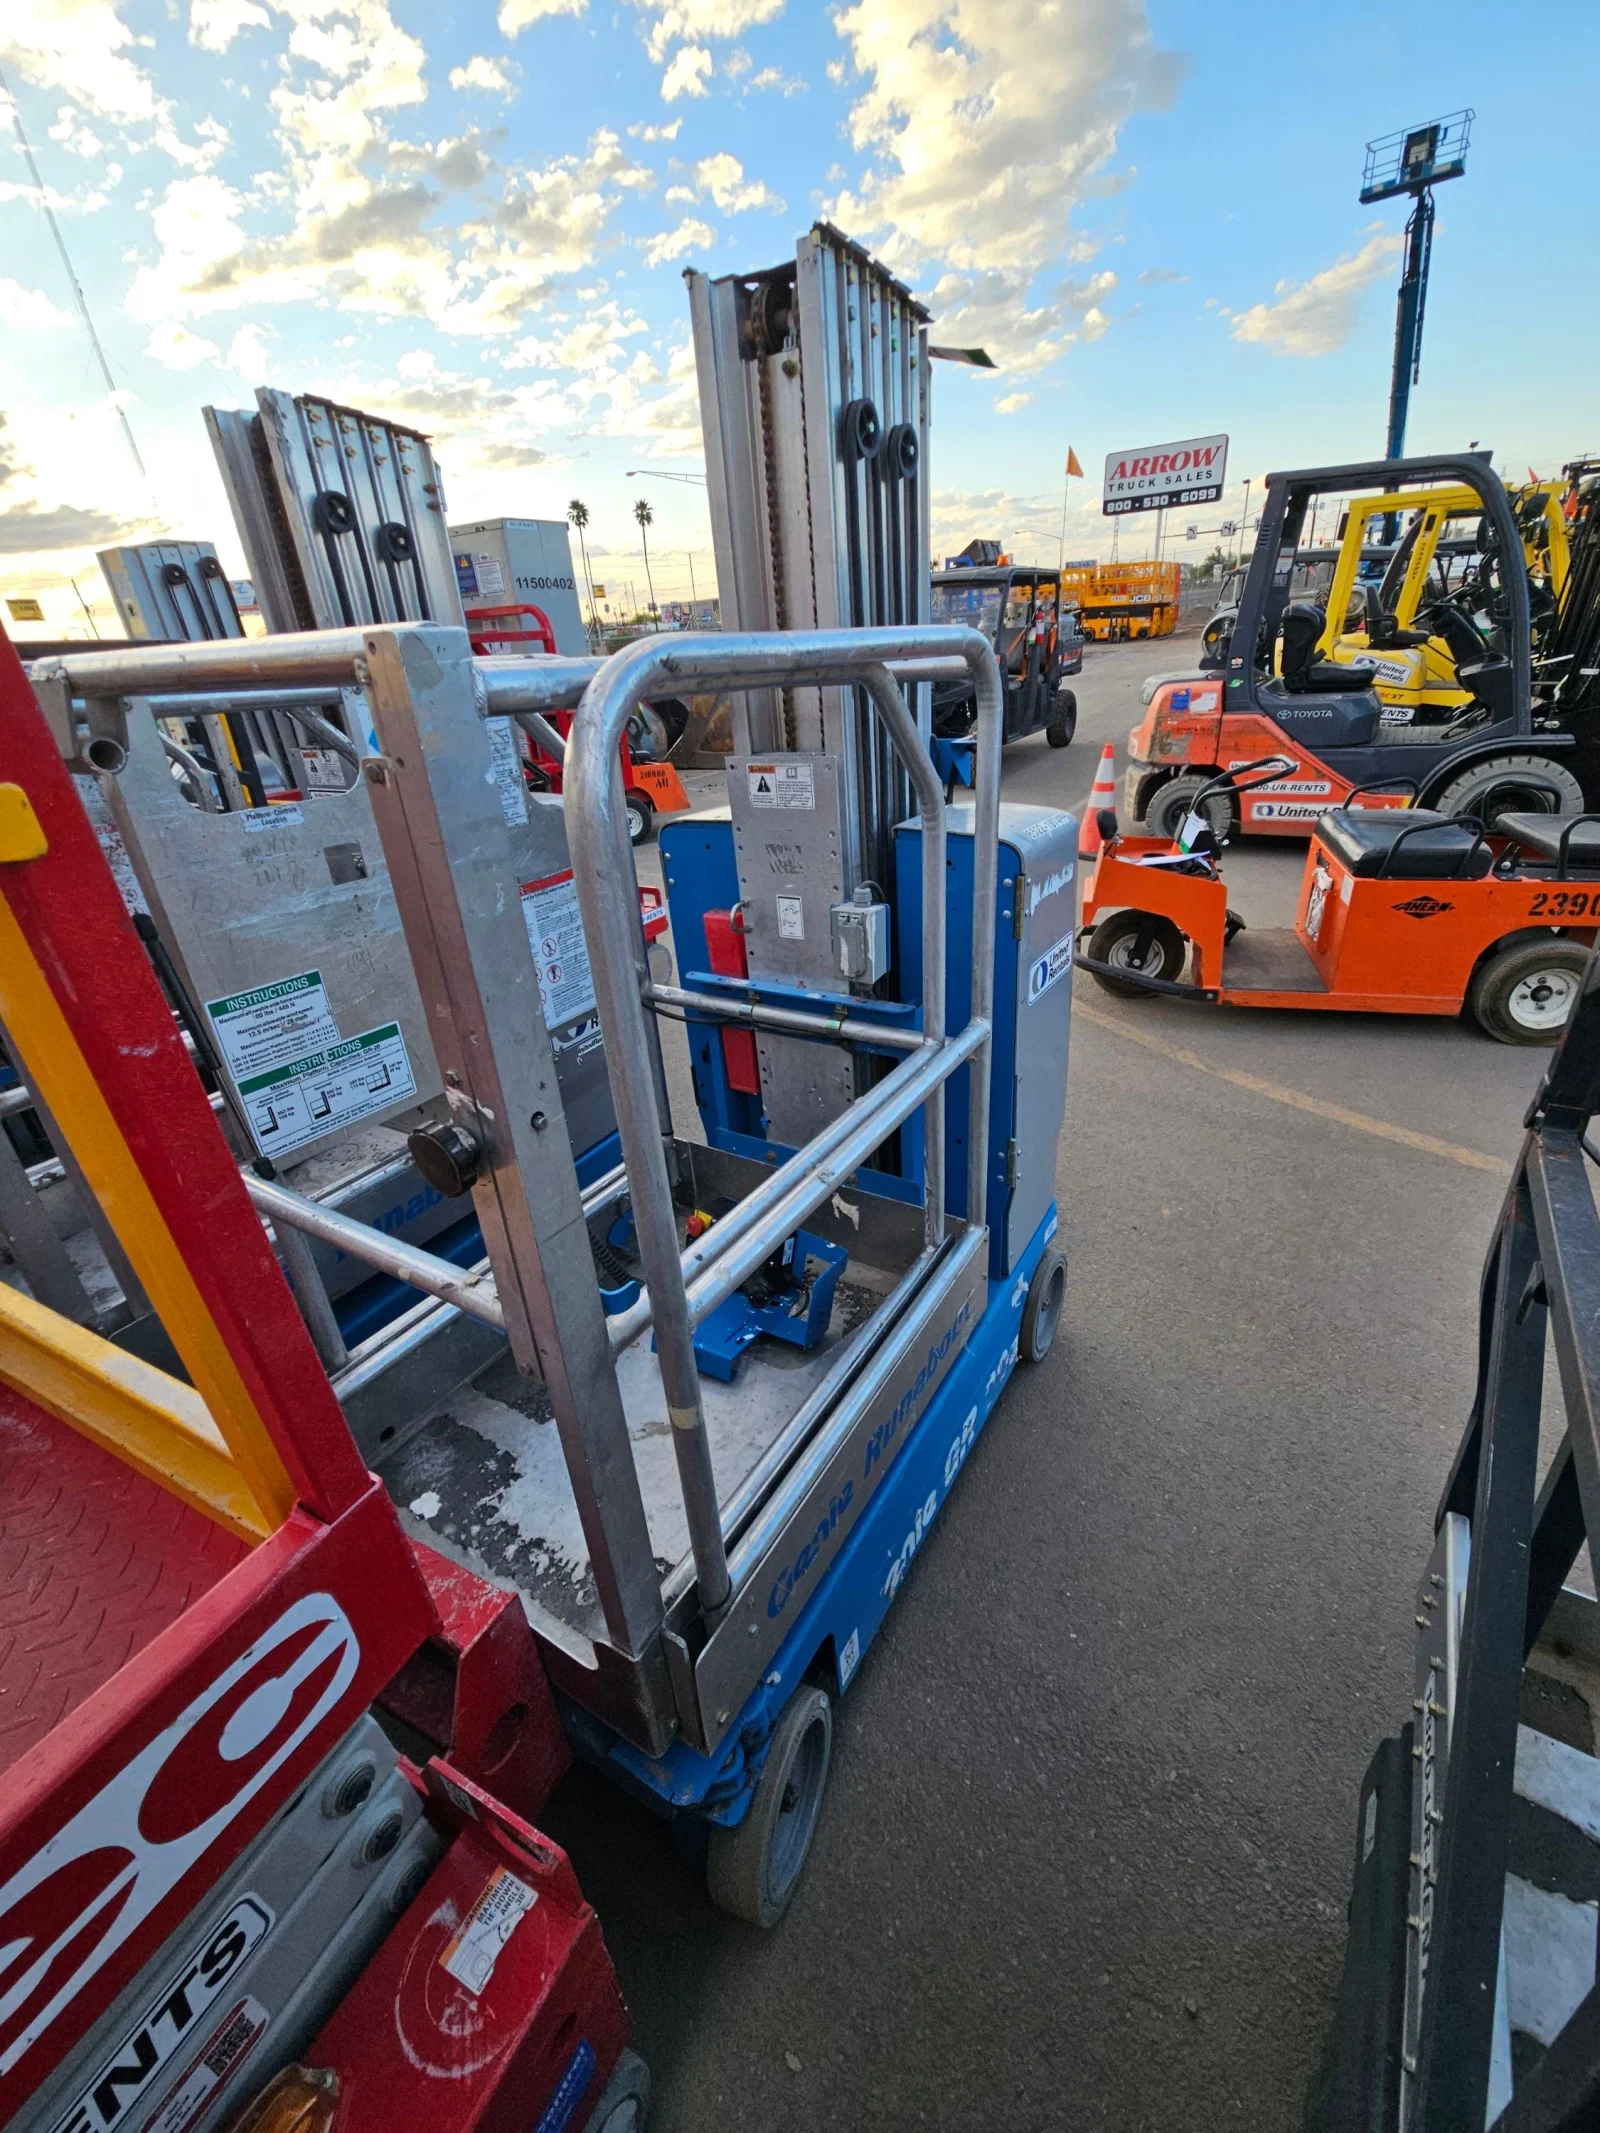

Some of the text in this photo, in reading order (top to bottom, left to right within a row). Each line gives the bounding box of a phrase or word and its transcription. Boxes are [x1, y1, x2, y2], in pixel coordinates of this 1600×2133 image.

[1109, 444, 1223, 480] ARROW
[1108, 470, 1212, 492] TRUCK SALES
[1106, 488, 1216, 512] 800 530 6099
[516, 577, 574, 590] 11500402
[1128, 594, 1152, 602] JCB
[1378, 662, 1406, 675] United
[1293, 710, 1333, 718] TOYOTA
[260, 816, 287, 825] Location
[273, 807, 296, 815] Controls
[1400, 902, 1451, 912] AHERN
[1049, 938, 1070, 966] United
[1048, 954, 1070, 982] Rentals
[226, 977, 308, 1010] INSTRUCTIONS
[218, 1013, 244, 1024] Maximum
[236, 1024, 262, 1034] Maximum
[262, 1015, 285, 1026] allowable
[248, 1029, 261, 1037] 12.5
[240, 1039, 265, 1050] Maximum
[269, 1076, 301, 1090] Maximum
[362, 1044, 380, 1054] GR-20
[289, 1040, 361, 1073] INSTRUCTIONS
[766, 1480, 854, 1619] Genie
[476, 1874, 510, 1924] MAXIMUM
[483, 1878, 516, 1927] TIE-DOWN
[500, 1883, 522, 1916] ANGLE
